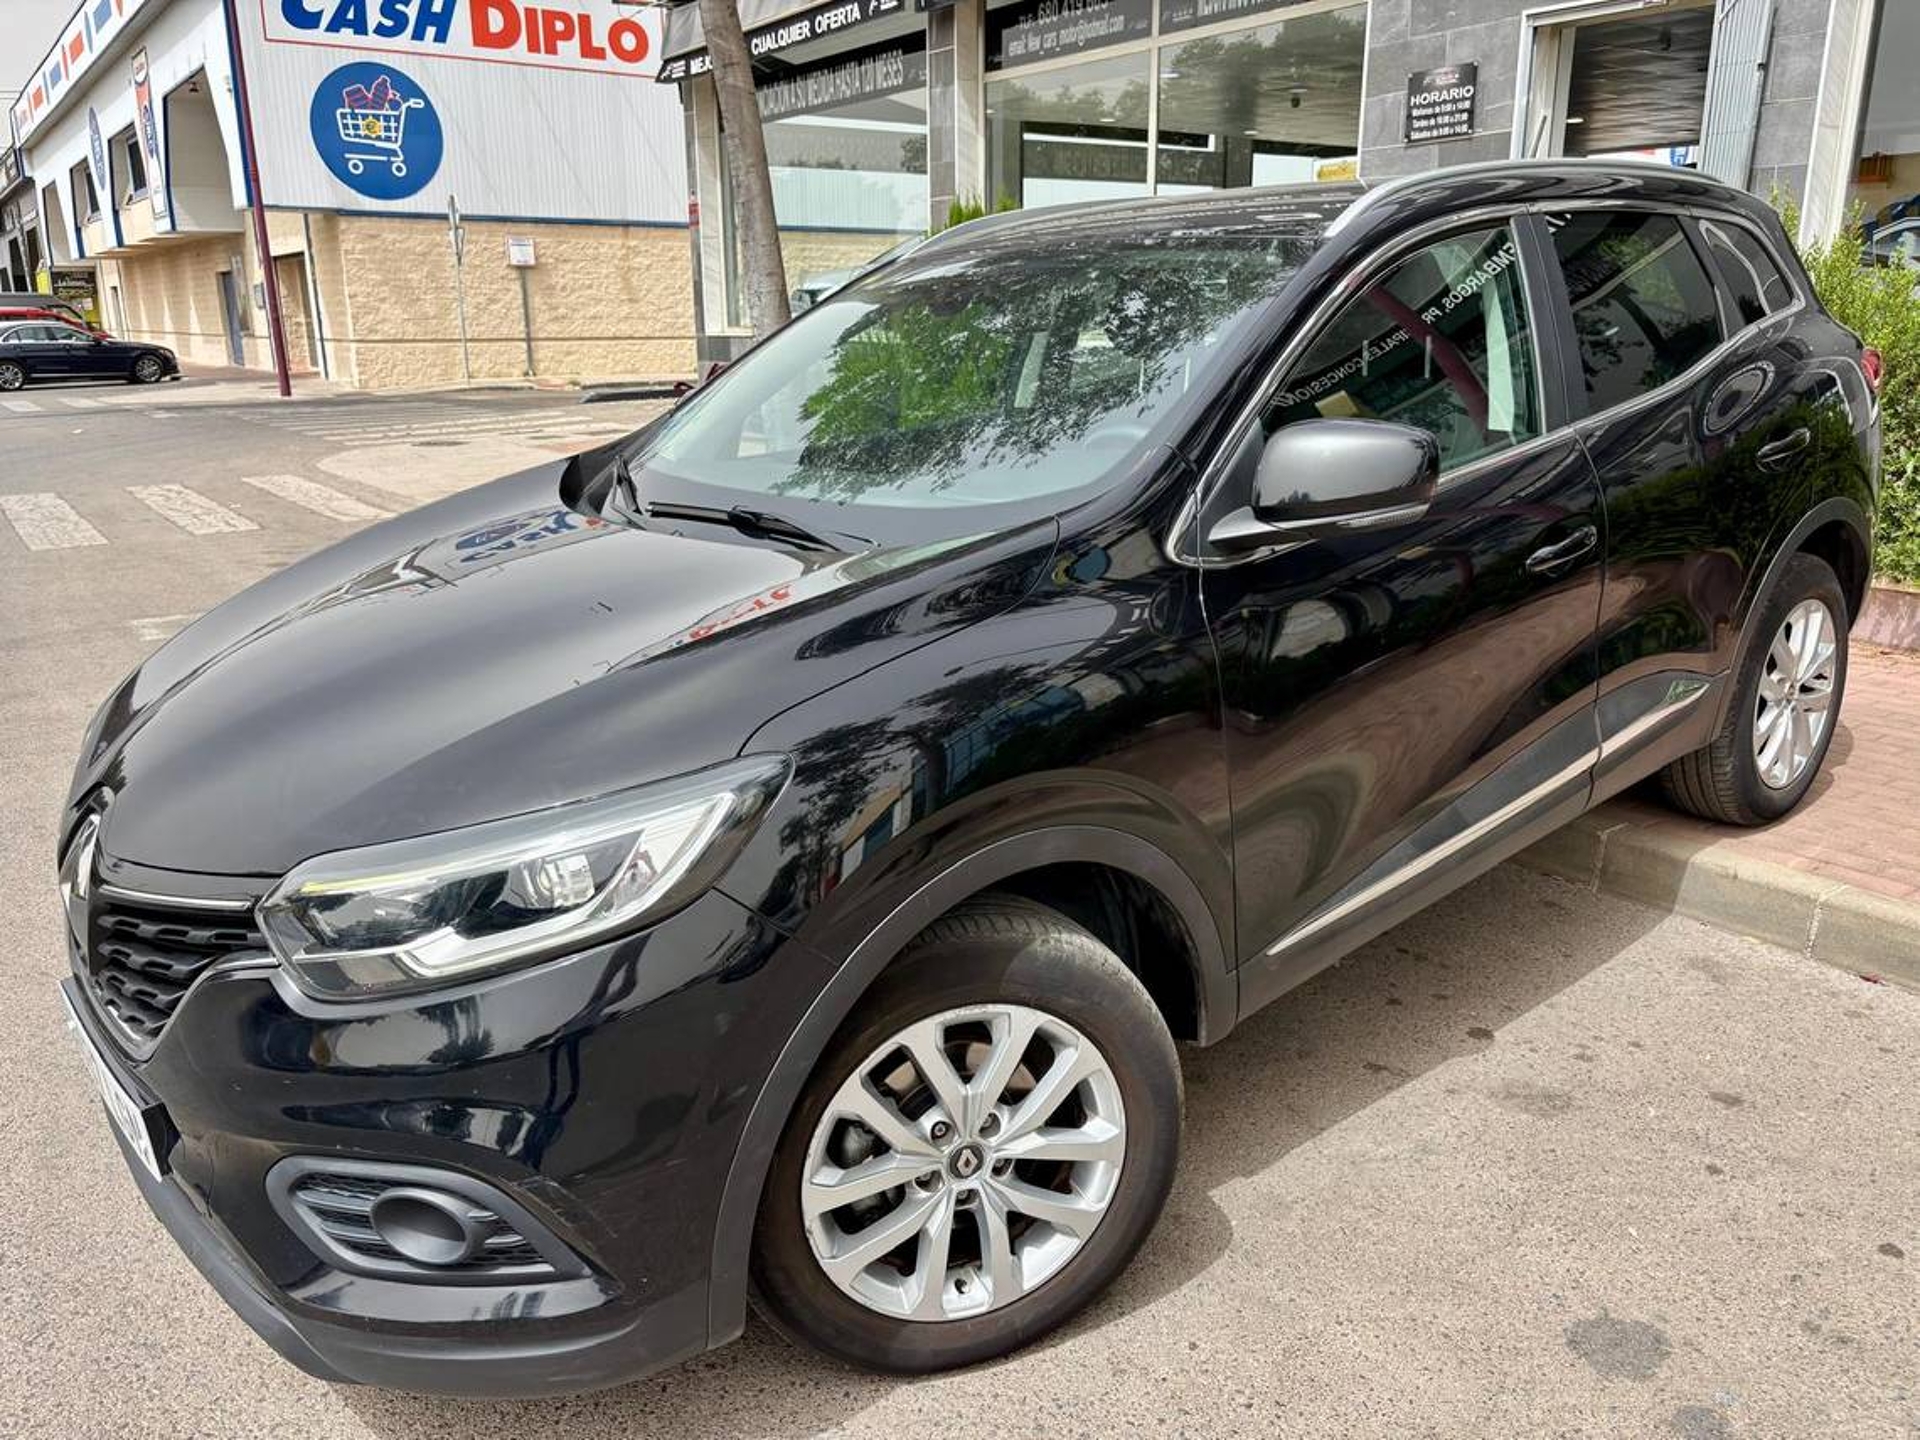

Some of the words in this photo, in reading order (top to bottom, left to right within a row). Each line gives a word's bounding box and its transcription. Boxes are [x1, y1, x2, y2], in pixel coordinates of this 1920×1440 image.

[469, 0, 649, 64] DIPLO
[751, 21, 811, 56] CUALQUIER
[815, 4, 861, 34] OFERTA
[1038, 1, 1059, 26] 680
[876, 48, 904, 89] MESES
[1410, 85, 1475, 107] HORARIO
